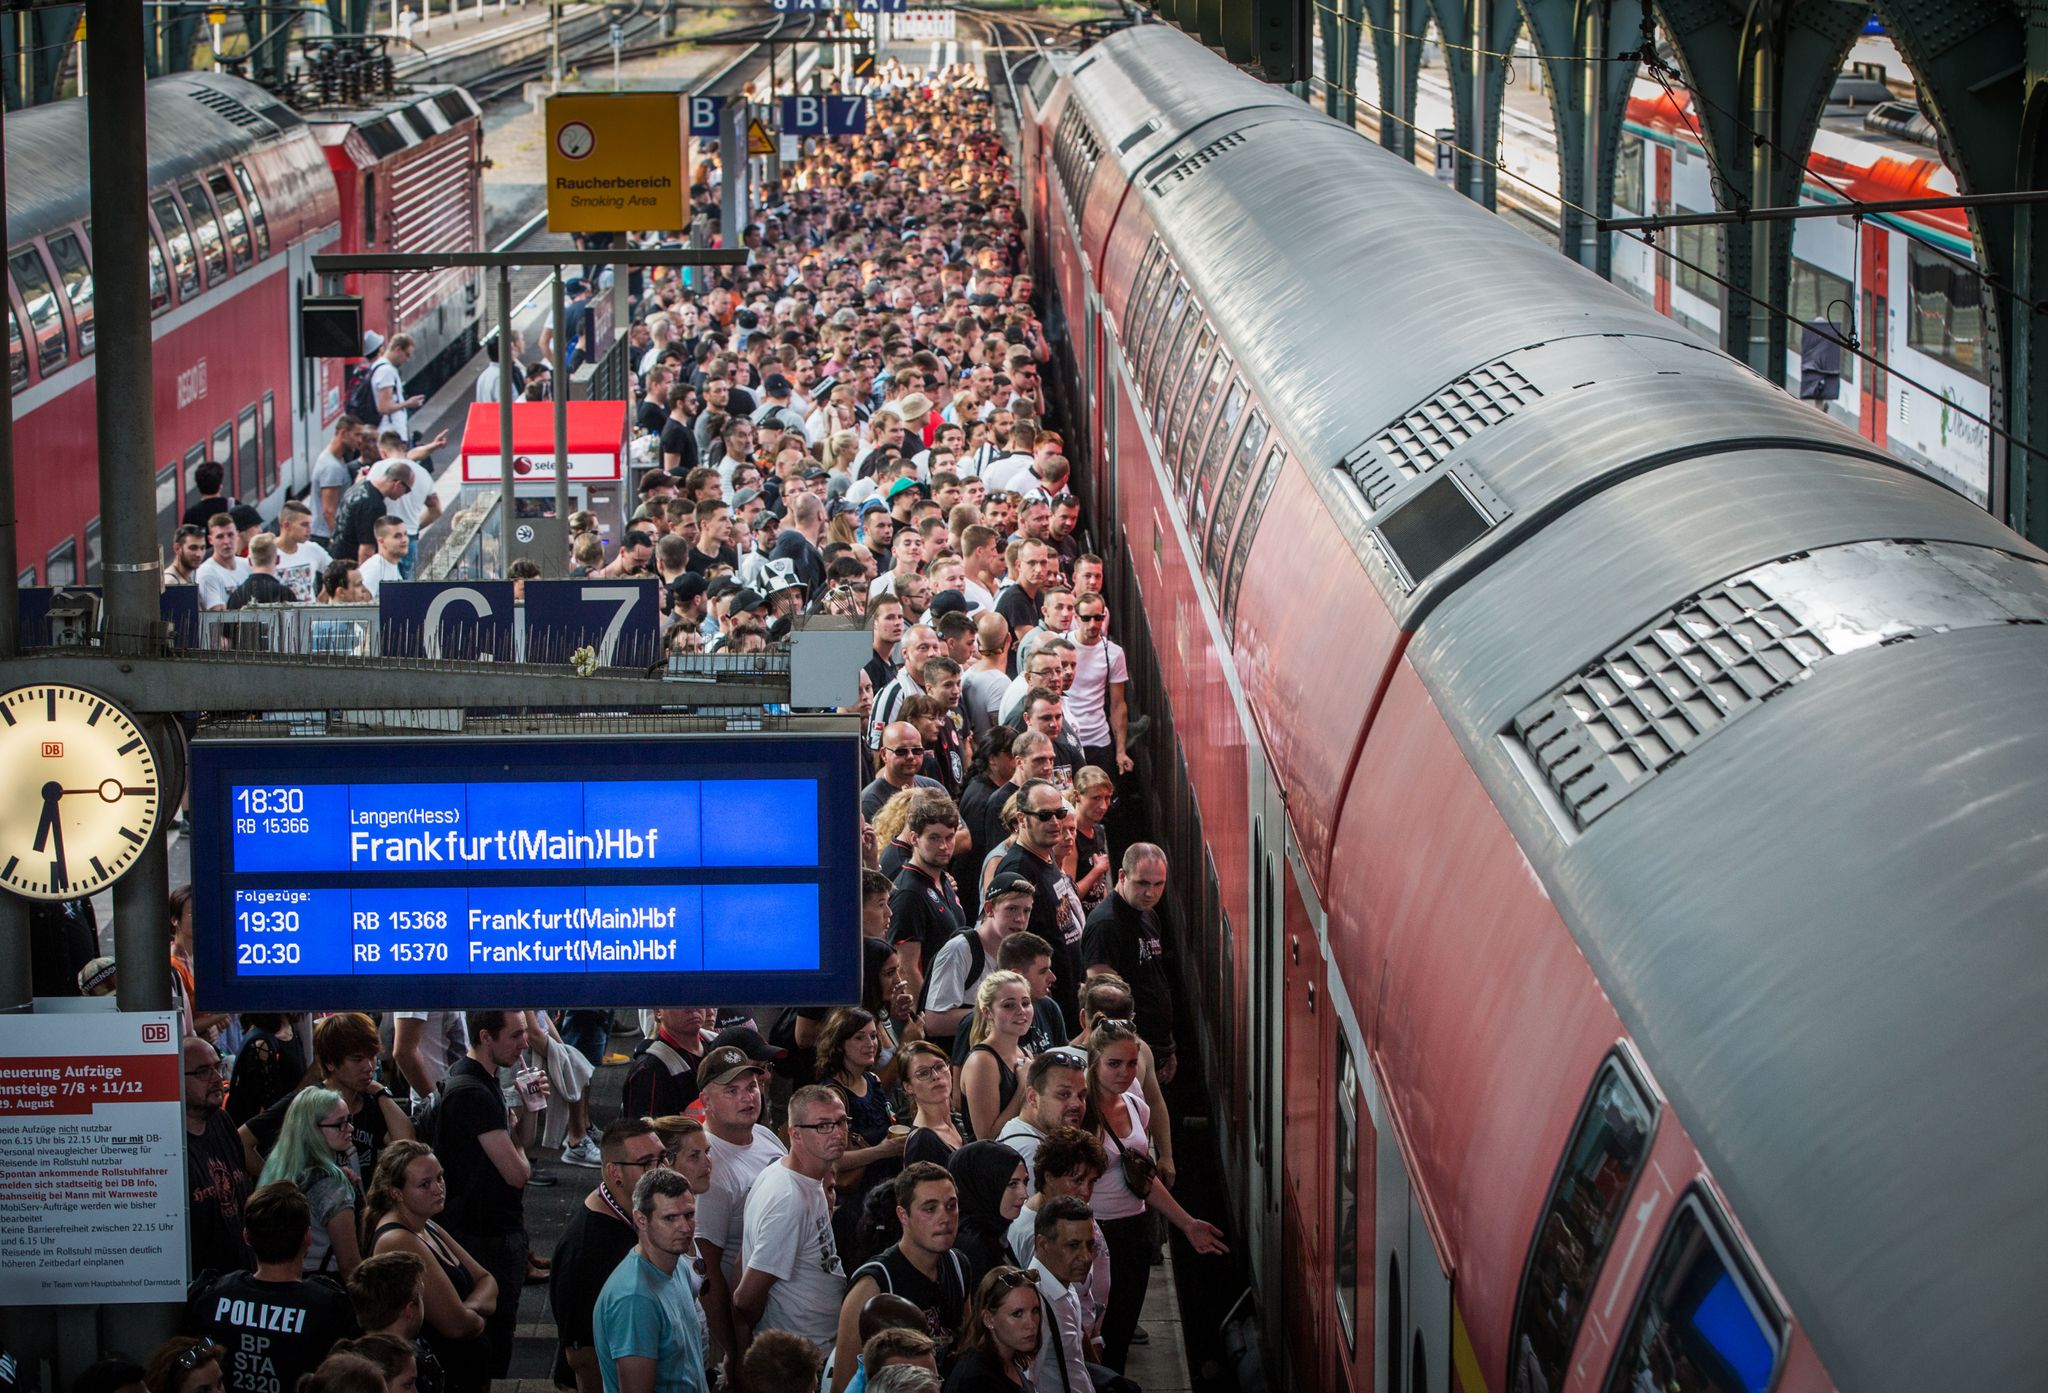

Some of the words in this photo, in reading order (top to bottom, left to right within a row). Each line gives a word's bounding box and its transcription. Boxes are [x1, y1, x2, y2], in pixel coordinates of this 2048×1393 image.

[693, 98, 715, 128] B
[796, 97, 819, 127] B
[842, 97, 862, 127] 7
[1437, 143, 1453, 169] H
[556, 176, 671, 189] Raucherbereich
[570, 195, 624, 208] Smoking
[627, 195, 657, 206] Area
[534, 459, 573, 470] selea
[581, 587, 640, 667] 7
[237, 789, 304, 814] 18:30
[351, 808, 460, 825] Langen(Hess)
[237, 819, 257, 834] RB
[262, 819, 309, 833] 15366
[352, 829, 658, 862] Frankfurt(Main)Hbf
[236, 891, 311, 904] Folgezüge:
[239, 912, 299, 932] 19:30
[353, 913, 379, 930] RB
[389, 912, 447, 929] 15368
[469, 909, 676, 930] Frankfurt(Main)Hbf
[239, 944, 300, 965] 20:30
[354, 945, 380, 962] RB
[391, 944, 448, 961] 15370
[469, 942, 676, 963] Frankfurt(Main)Hbf
[65, 1065, 122, 1078] Aufzüge
[61, 1082, 85, 1096] 7/8
[89, 1084, 98, 1093] +
[101, 1080, 143, 1096] 11/12
[16, 1099, 55, 1110] August
[22, 1125, 56, 1134] Aufzüge
[59, 1125, 79, 1133] nicht
[81, 1125, 112, 1133] nutzbar
[15, 1136, 32, 1145] 6.15
[36, 1136, 50, 1144] Uhr
[53, 1136, 65, 1144] bis
[68, 1136, 91, 1144] 22.15
[94, 1135, 110, 1143] Uhr
[112, 1136, 128, 1144] nur
[130, 1135, 143, 1143] mit
[146, 1134, 162, 1142] DB-
[37, 1147, 97, 1157] niveaugleicher
[101, 1146, 137, 1155] Überweg
[140, 1146, 151, 1154] für
[40, 1158, 50, 1166] im
[53, 1158, 89, 1166] Rollstuhl
[91, 1157, 122, 1165] nutzbar
[0, 1170, 36, 1179] Spontan
[39, 1169, 99, 1178] ankommende
[102, 1168, 168, 1176] Rollstuhlfahrer
[0, 1181, 32, 1189] melden
[35, 1180, 53, 1189] sich
[56, 1179, 103, 1190] stadtseitig
[105, 1179, 118, 1187] bei
[121, 1179, 134, 1187] DB
[137, 1179, 157, 1188] Info,
[0, 1192, 46, 1202] bahnseitig
[49, 1191, 62, 1200] bei
[65, 1191, 89, 1199] Mann
[92, 1191, 106, 1199] mit
[109, 1190, 157, 1198] Warnweste
[1, 1203, 77, 1213] MobiServ-Aufträge
[81, 1202, 112, 1210] werden
[131, 1201, 156, 1209] bisher
[1, 1215, 42, 1223] bearbeitet
[1, 1226, 25, 1234] Keine
[28, 1224, 89, 1233] Barrierefreiheit
[91, 1224, 130, 1232] zwischen
[132, 1224, 155, 1232] 22.15
[159, 1223, 174, 1231] Uhr
[1, 1237, 16, 1245] und
[20, 1237, 37, 1245] 6.15
[40, 1236, 55, 1245] Uhr
[2, 1248, 41, 1256] Reisende
[43, 1247, 53, 1255] im
[57, 1247, 92, 1255] Rollstuhl
[95, 1247, 128, 1255] müssen
[130, 1245, 162, 1254] deutlich
[2, 1259, 36, 1268] höheren
[39, 1258, 81, 1267] Zeitbedarf
[84, 1258, 124, 1267] einplanen
[91, 1280, 142, 1288] Hauptbahnhof
[144, 1279, 180, 1287] Darmstadt
[214, 1297, 306, 1333] POLIZEI
[241, 1334, 270, 1354] BP
[234, 1352, 276, 1376] STA
[233, 1371, 280, 1393] 2320
